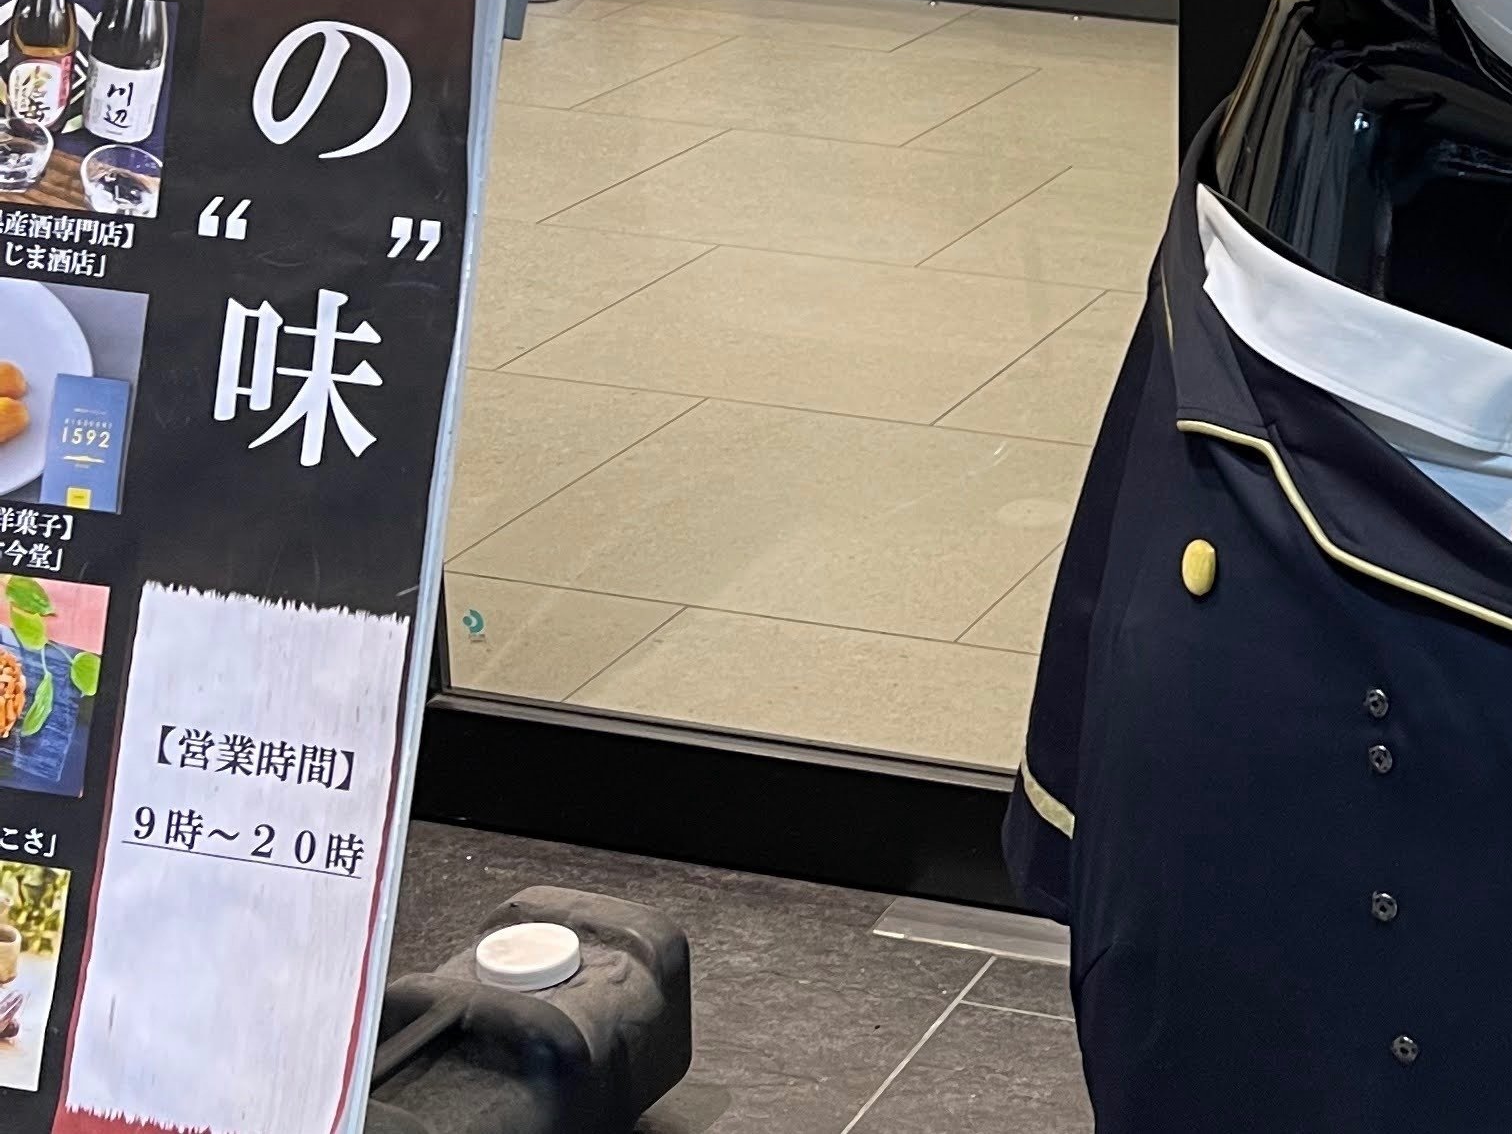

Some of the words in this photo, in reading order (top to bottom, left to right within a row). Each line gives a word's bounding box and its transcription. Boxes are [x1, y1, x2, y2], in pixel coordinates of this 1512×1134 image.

[0, 209, 136, 250] 産酒専門店】
[4, 241, 108, 278] じま酒店」
[61, 426, 112, 449] 1592
[0, 539, 63, 573] 今堂」
[155, 724, 355, 792] 【営業時間】
[0, 827, 57, 858] こさ」
